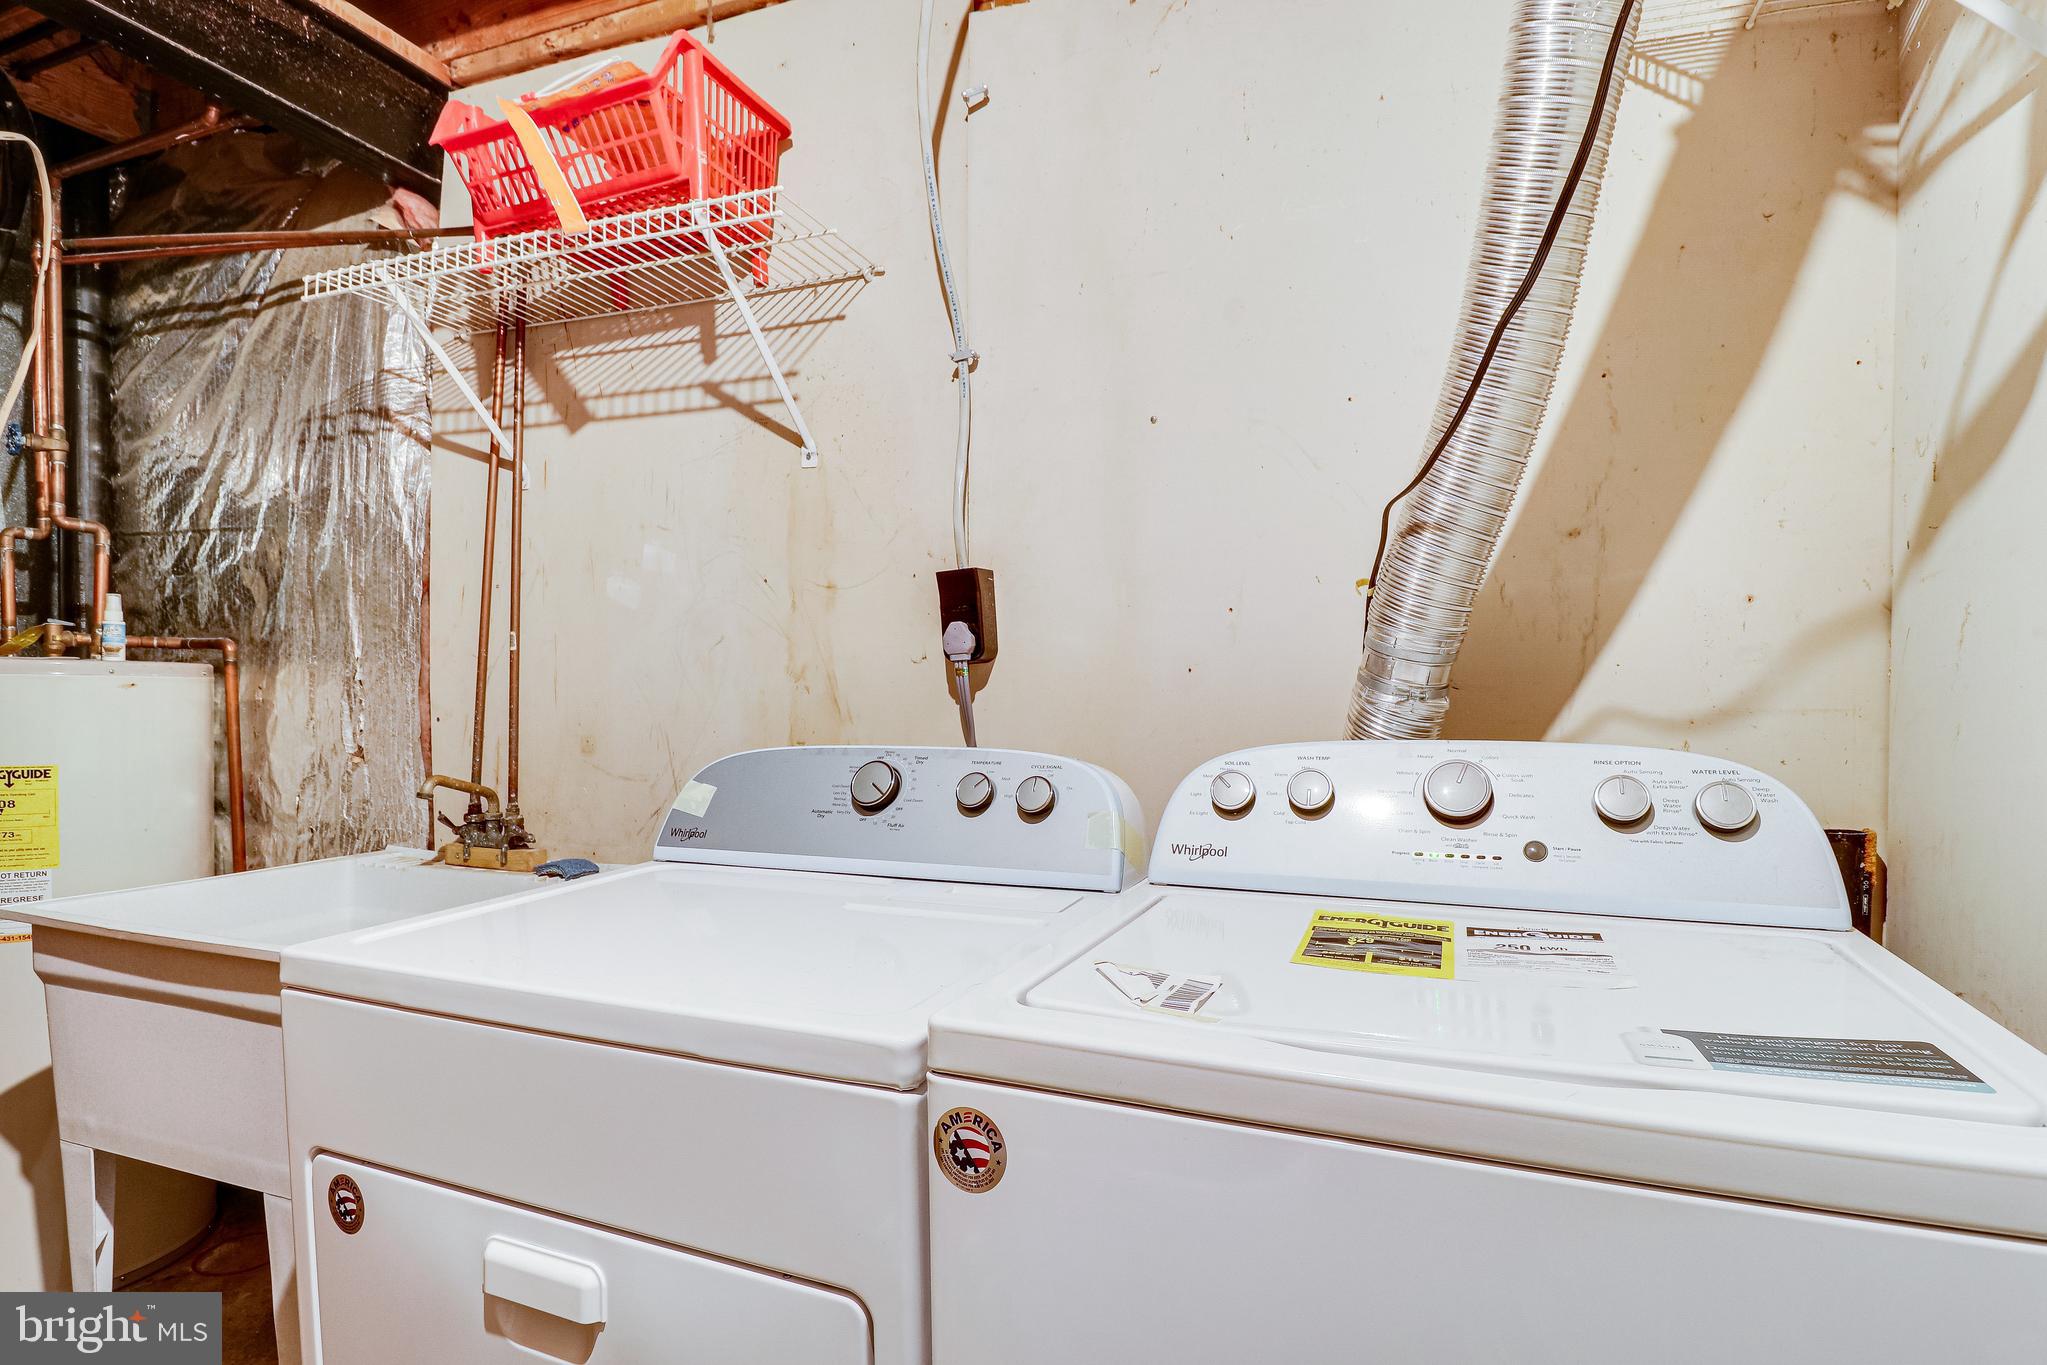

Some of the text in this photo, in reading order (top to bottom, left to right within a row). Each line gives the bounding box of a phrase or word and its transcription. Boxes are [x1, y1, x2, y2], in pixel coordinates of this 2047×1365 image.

[671, 827, 708, 841] Whirlpool
[1171, 843, 1228, 860] Whirlpool
[14, 870, 48, 879] RETURN
[941, 1112, 1002, 1153] AMERICA
[330, 1177, 360, 1204] AMERICA
